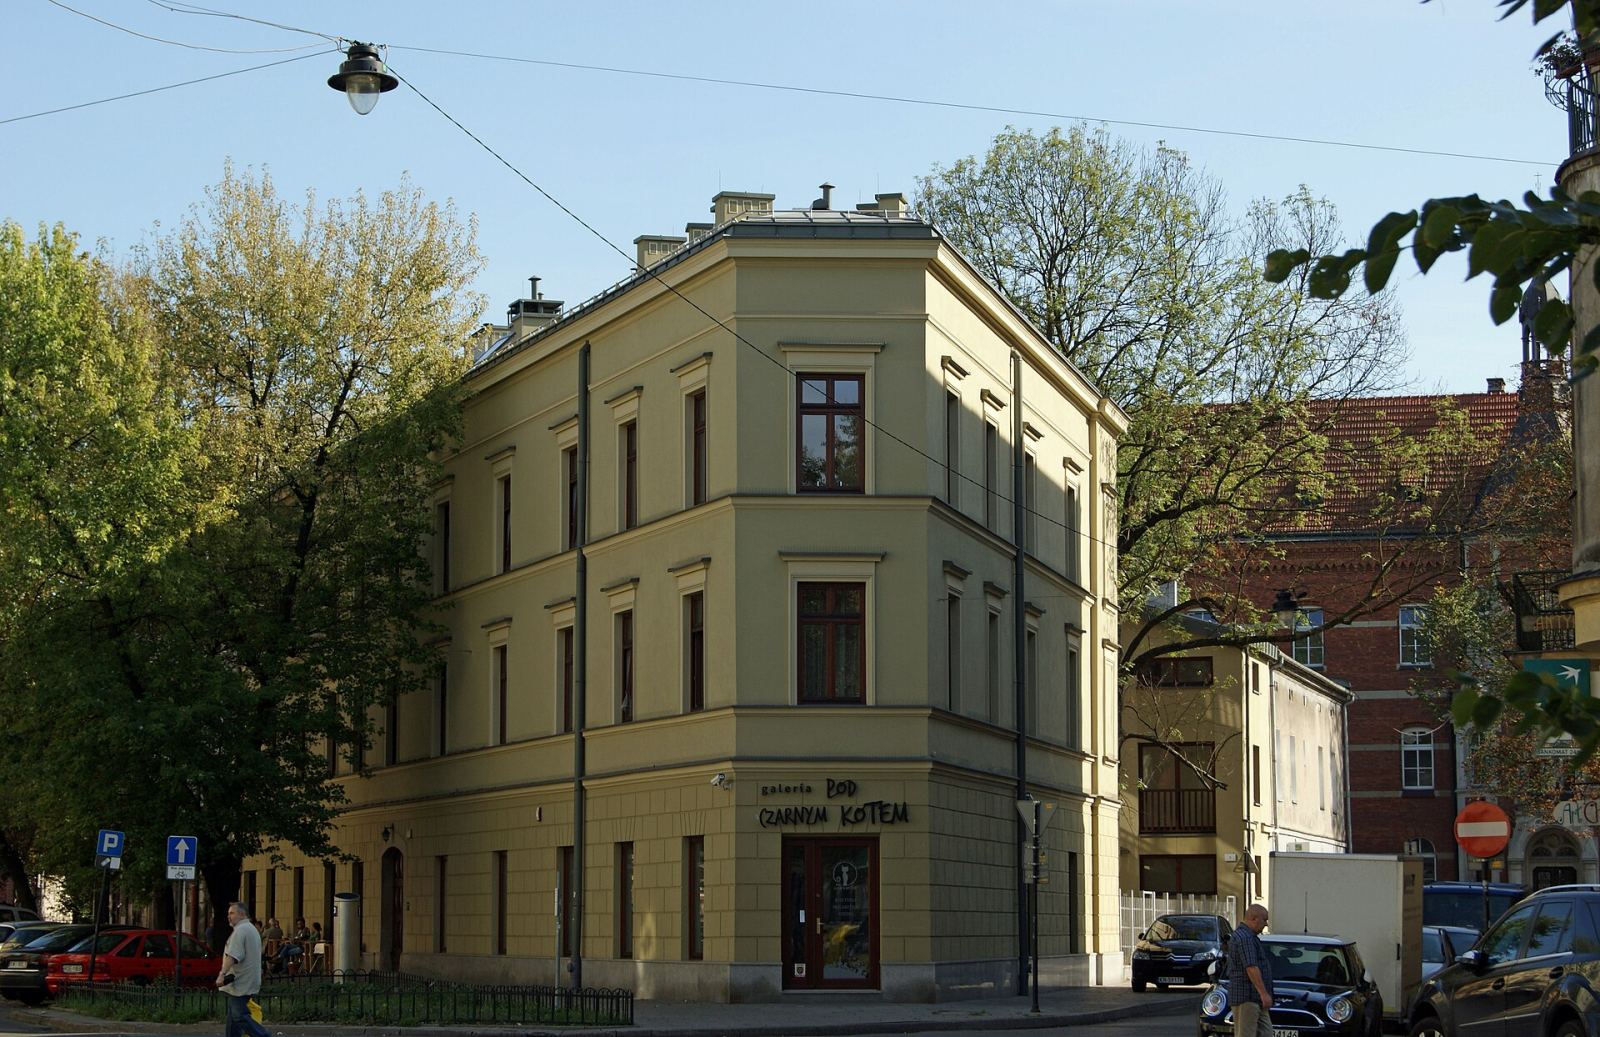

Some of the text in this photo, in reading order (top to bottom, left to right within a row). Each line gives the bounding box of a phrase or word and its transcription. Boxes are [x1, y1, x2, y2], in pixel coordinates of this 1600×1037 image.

[761, 778, 857, 798] galeria POD
[759, 801, 909, 828] CZARNYM KOTEM
[103, 833, 118, 852] P
